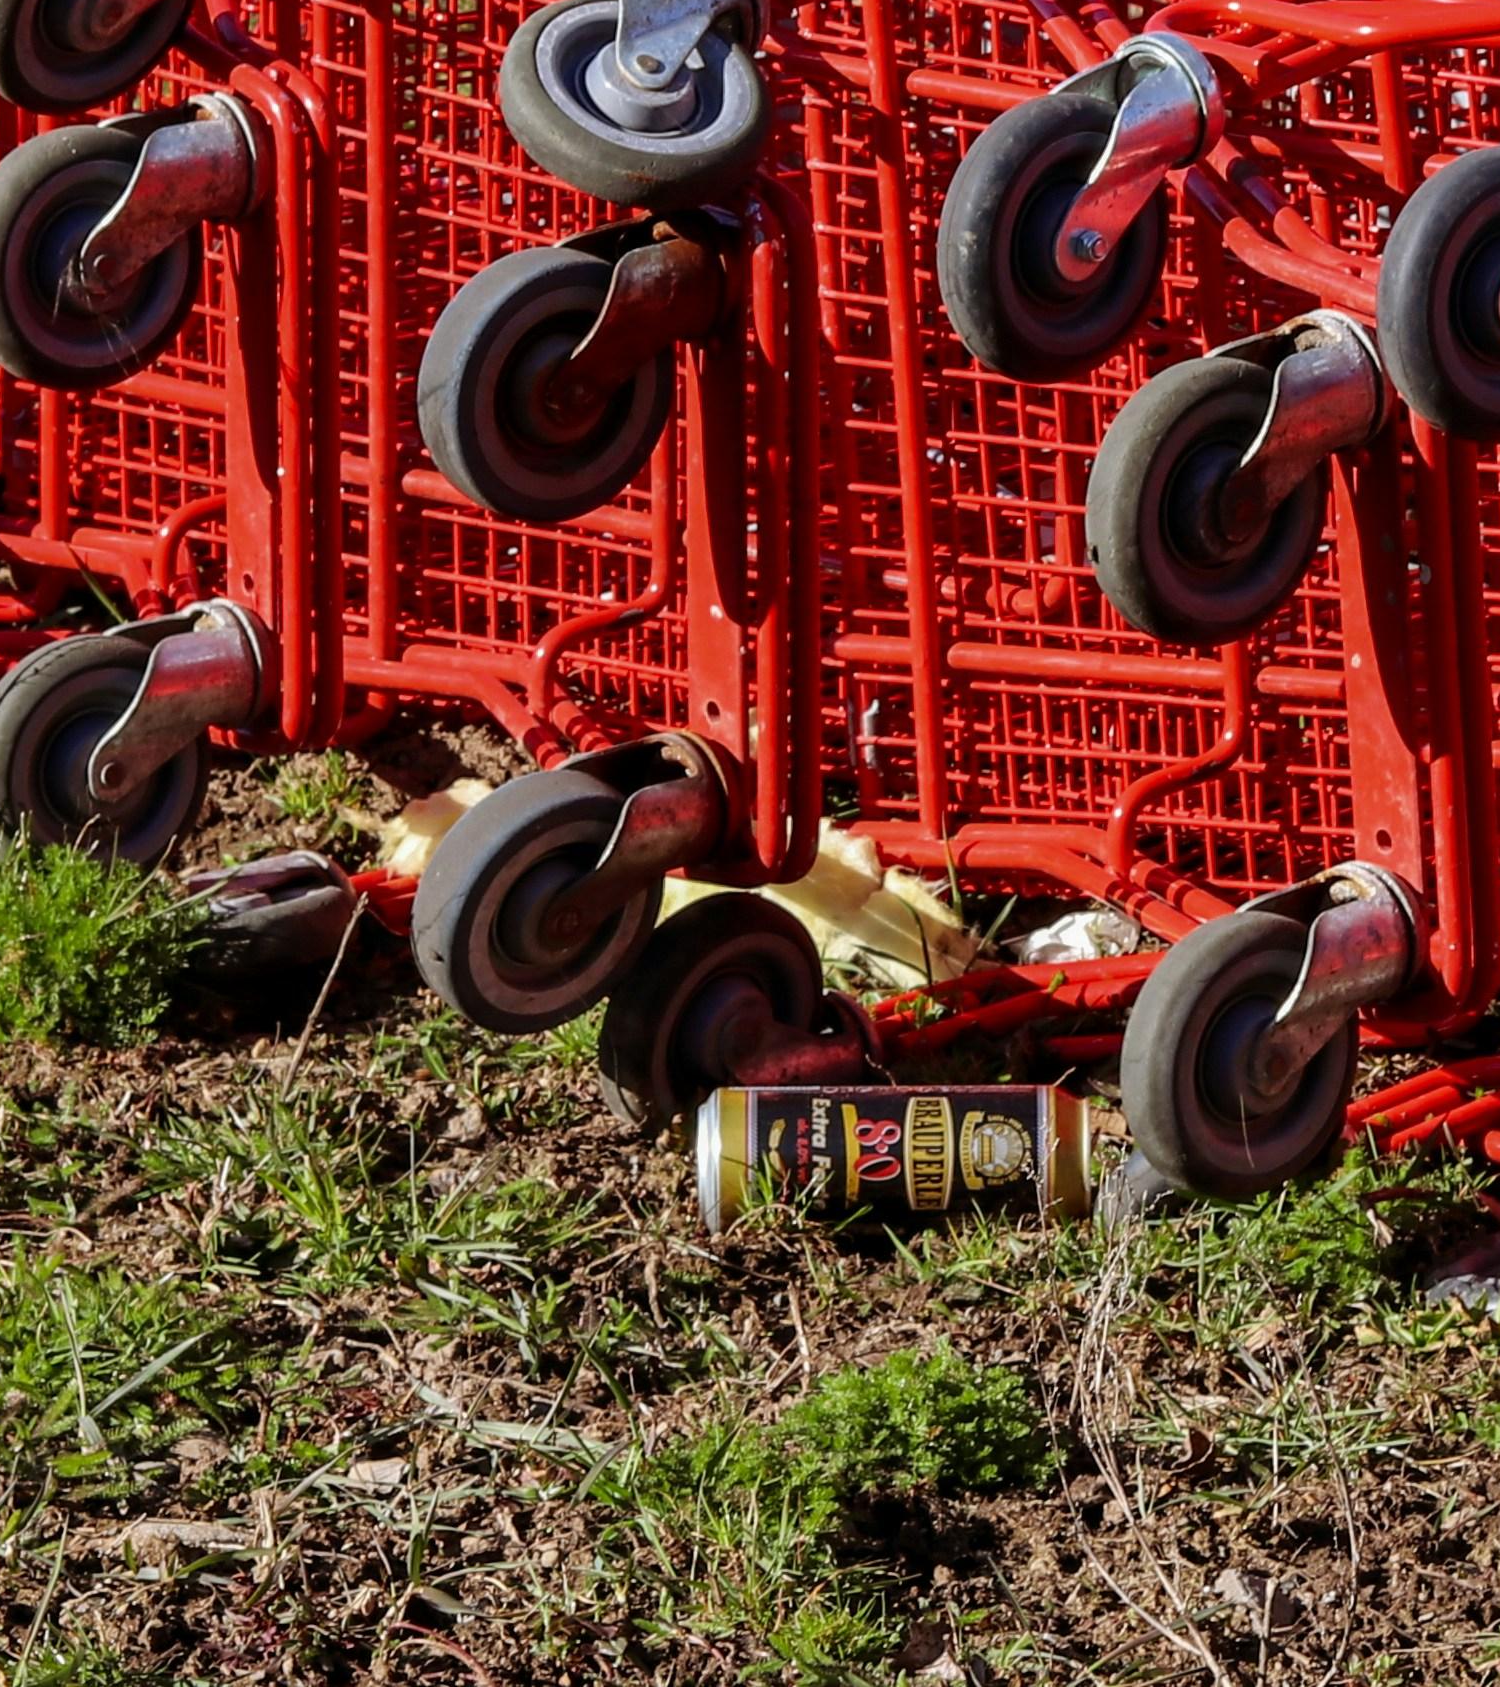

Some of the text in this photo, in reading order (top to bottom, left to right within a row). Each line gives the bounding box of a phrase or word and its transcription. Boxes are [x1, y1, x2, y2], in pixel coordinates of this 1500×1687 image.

[811, 1098, 831, 1148] Extra
[912, 1099, 945, 1207] BRAUPERLE
[961, 1119, 973, 1179] TRADITION
